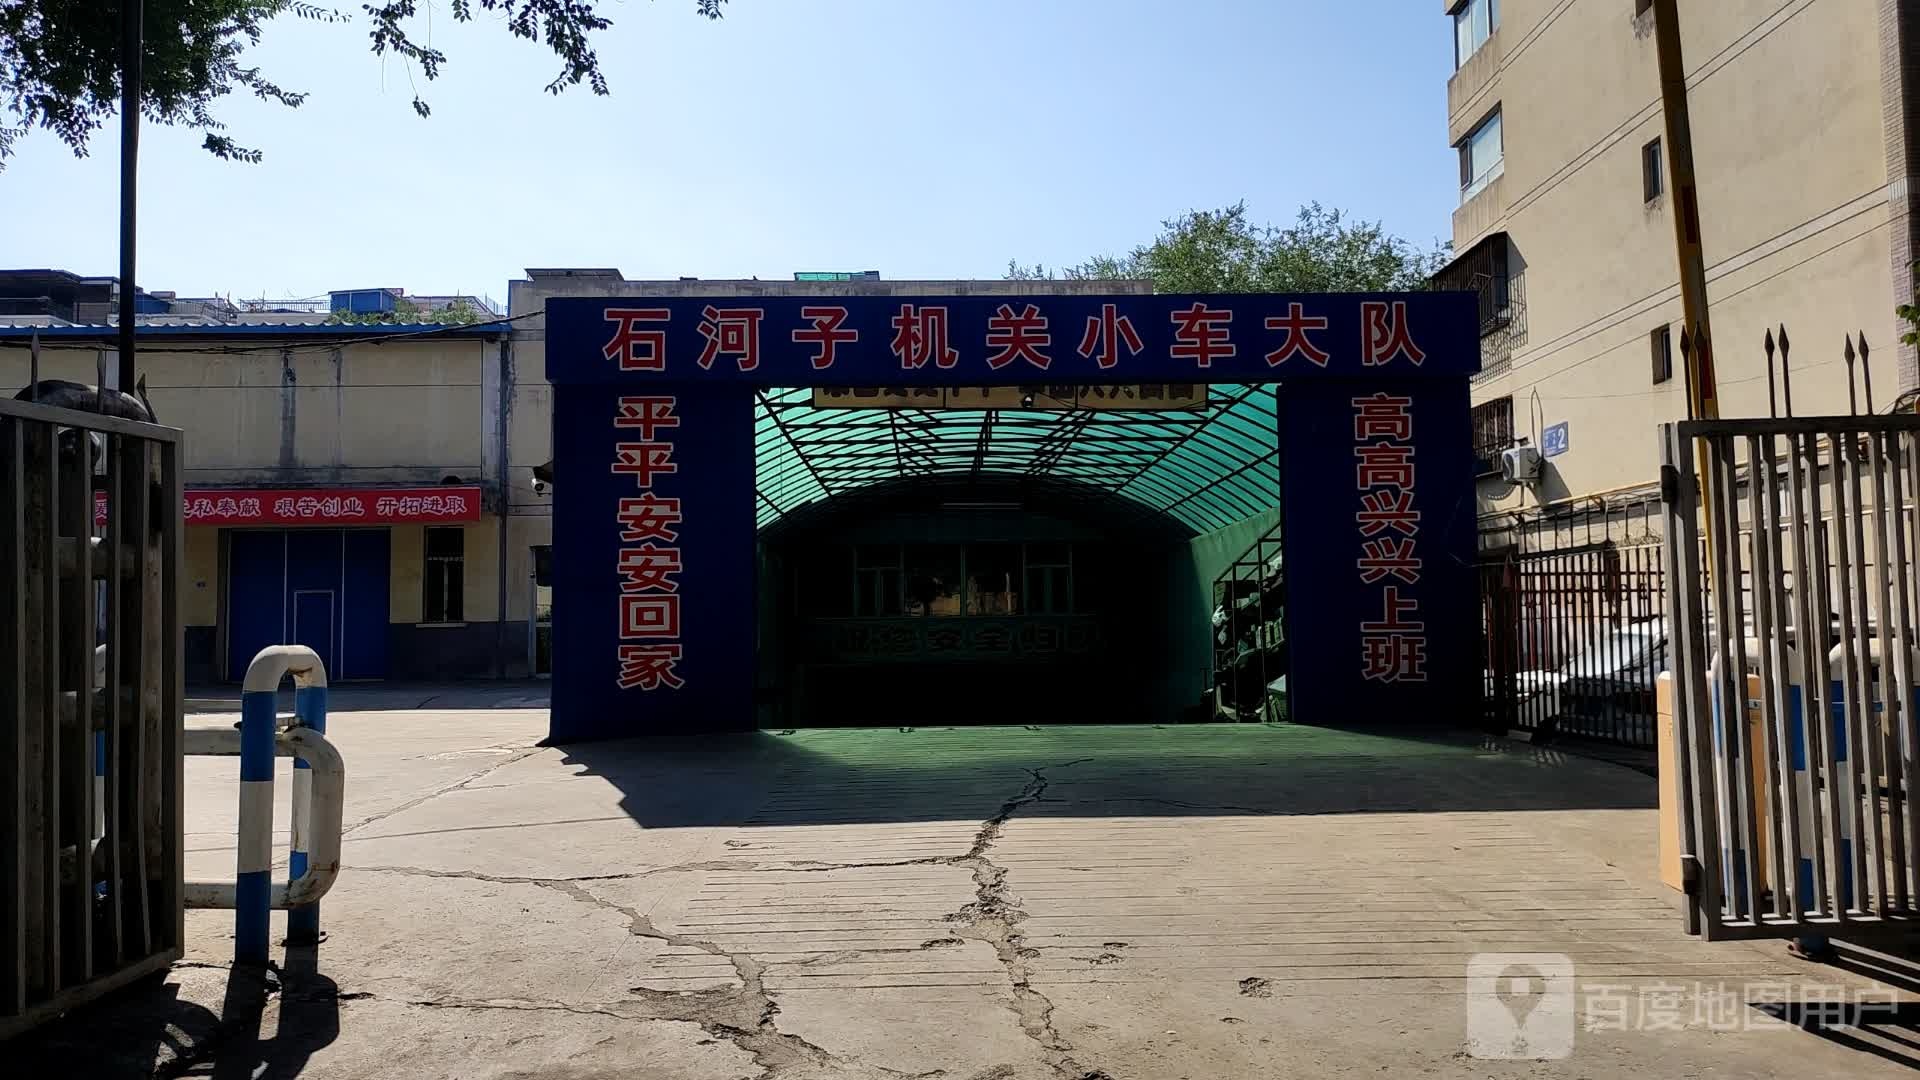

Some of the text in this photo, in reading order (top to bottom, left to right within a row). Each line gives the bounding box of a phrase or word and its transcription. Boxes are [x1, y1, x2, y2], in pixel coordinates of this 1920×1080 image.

[602, 302, 1427, 373] 石河子机关小车大队
[273, 497, 366, 517] 艰苦创业
[376, 495, 467, 515] 开拓进取
[611, 395, 685, 690] 平平安安回家
[1351, 393, 1428, 684] 高高兴兴上班
